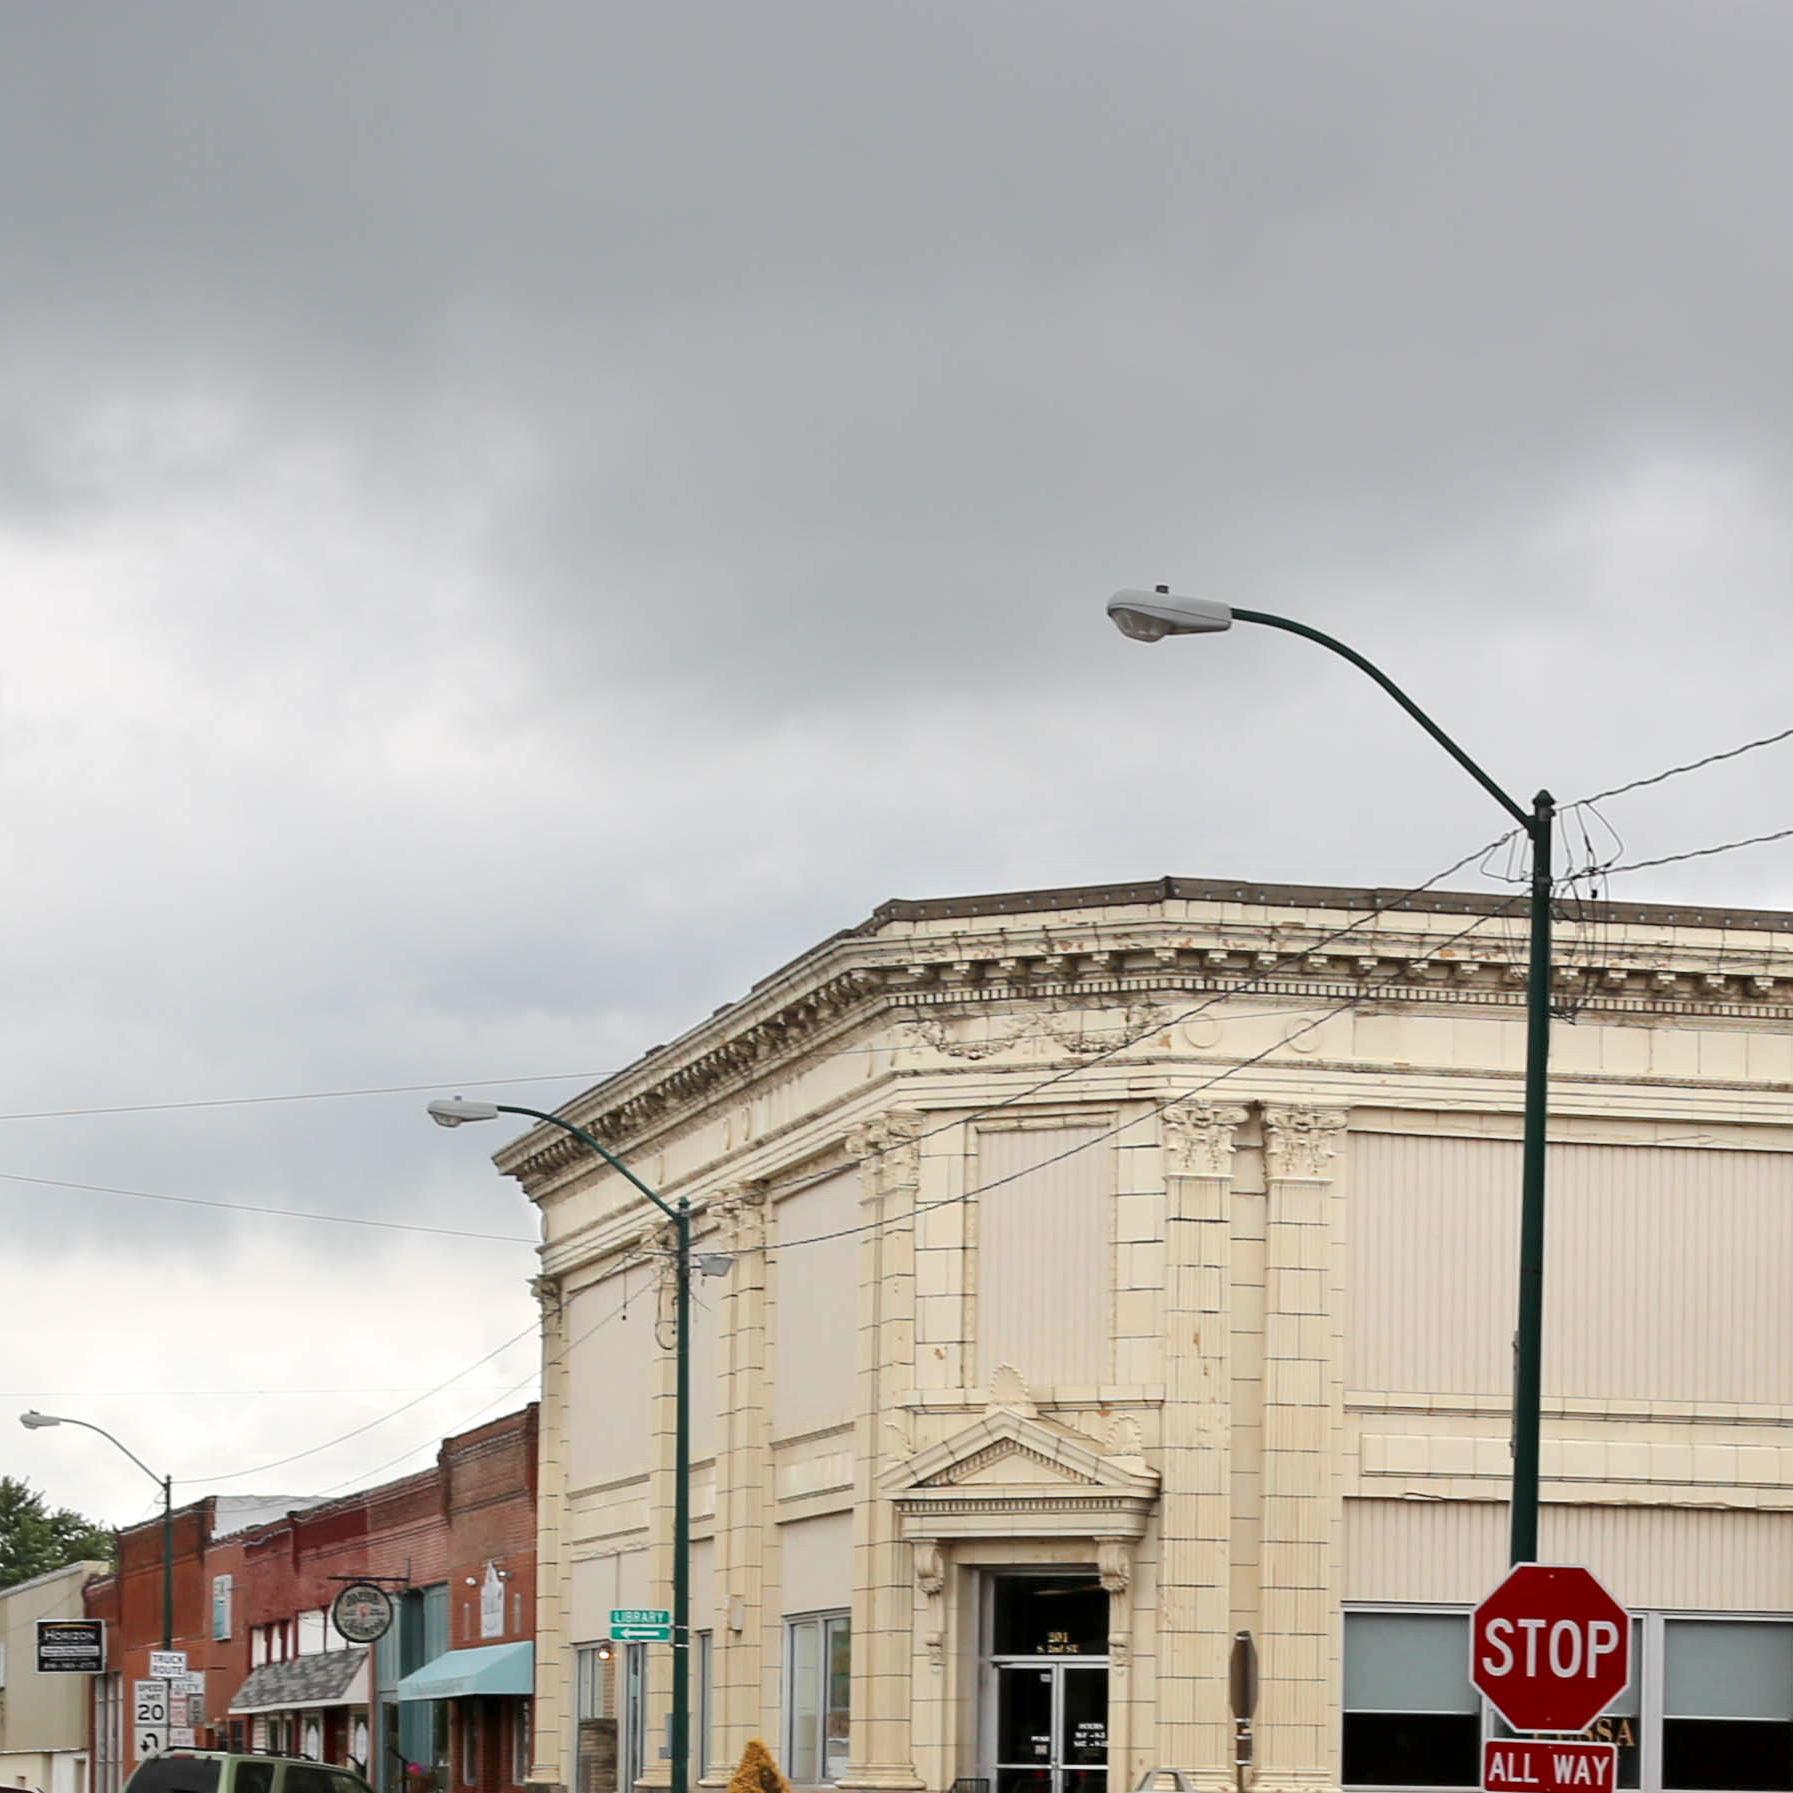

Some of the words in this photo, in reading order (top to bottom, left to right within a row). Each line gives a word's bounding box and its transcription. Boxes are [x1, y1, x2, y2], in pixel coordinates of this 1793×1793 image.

[614, 1611, 664, 1623] LIBRARY
[45, 1629, 96, 1641] HORIZON
[1482, 1617, 1619, 1679] STOP
[152, 1654, 184, 1664] TRUCK
[152, 1665, 184, 1675] ROUTE
[138, 1684, 164, 1692] SPEED
[137, 1704, 164, 1721] 20
[1488, 1752, 1540, 1783] ALL
[1553, 1754, 1610, 1786] WAY
